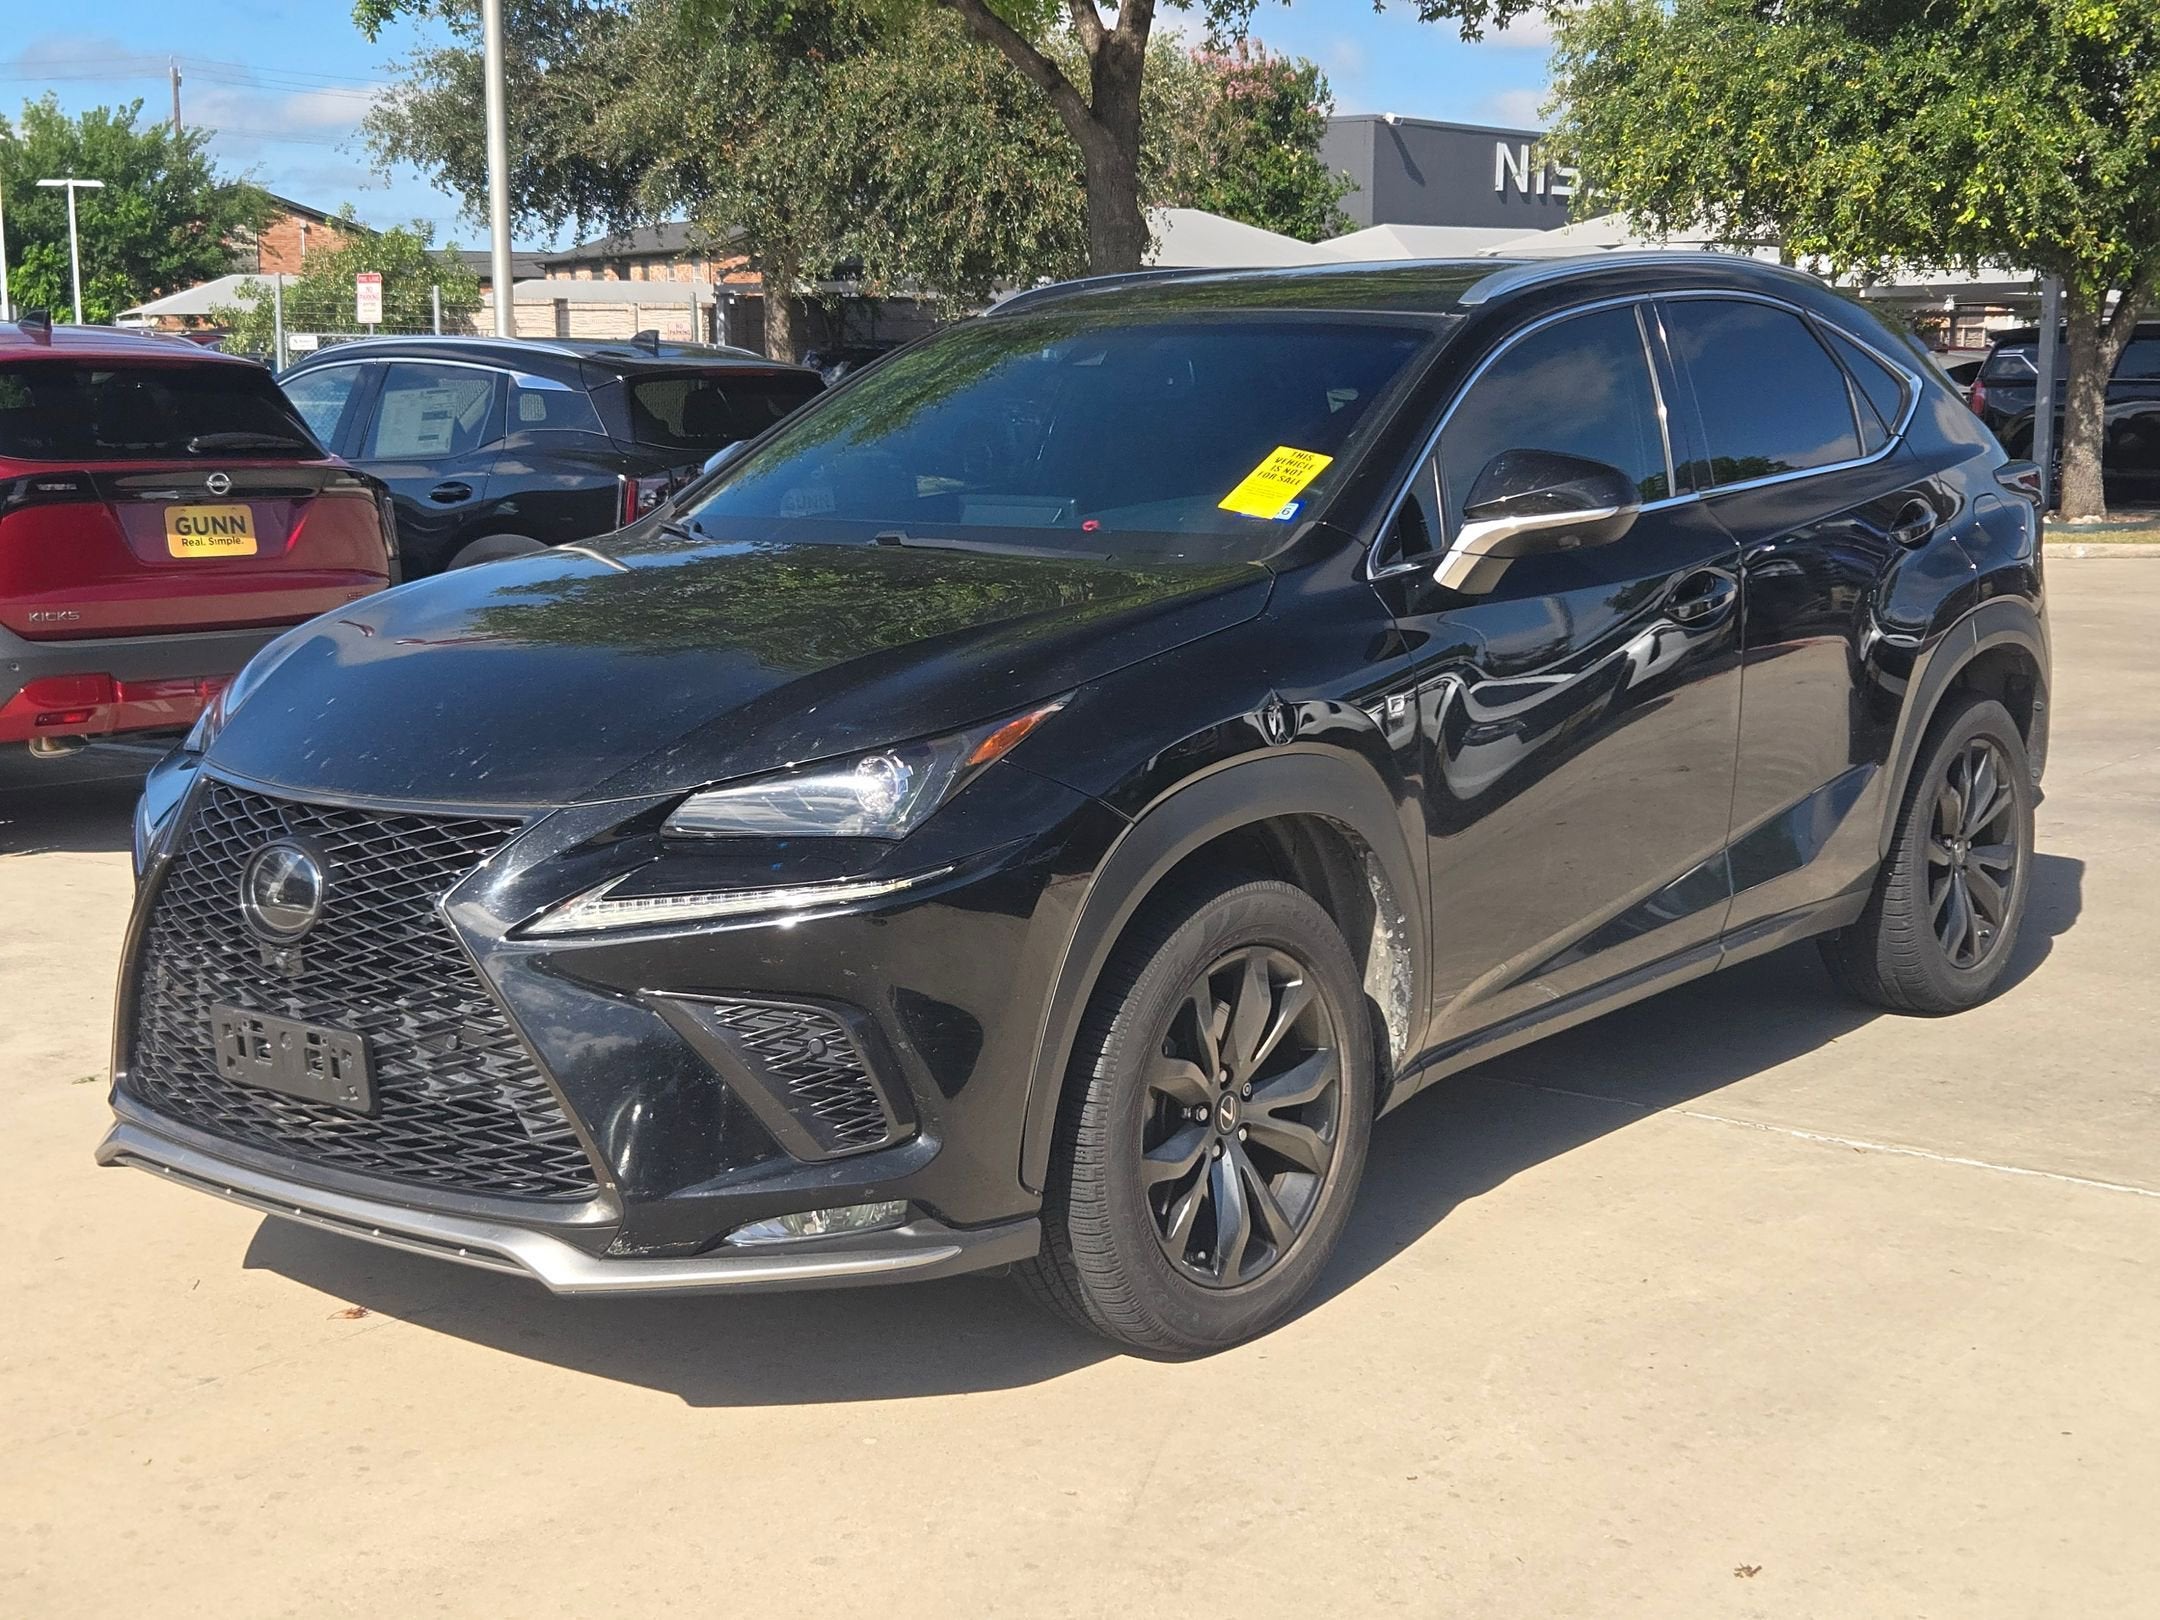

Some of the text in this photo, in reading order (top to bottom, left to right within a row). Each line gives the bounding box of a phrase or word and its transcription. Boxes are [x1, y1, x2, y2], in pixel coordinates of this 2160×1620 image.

[1494, 142, 1605, 197] NIS
[1290, 451, 1314, 461] THIS
[1275, 457, 1314, 471] VEHICLE
[1257, 471, 1301, 486] FOR SALE
[1284, 468, 1303, 477] NOT
[175, 515, 246, 536] GUNN
[181, 536, 245, 547] Real. Simple.
[28, 610, 81, 622] KICKS
